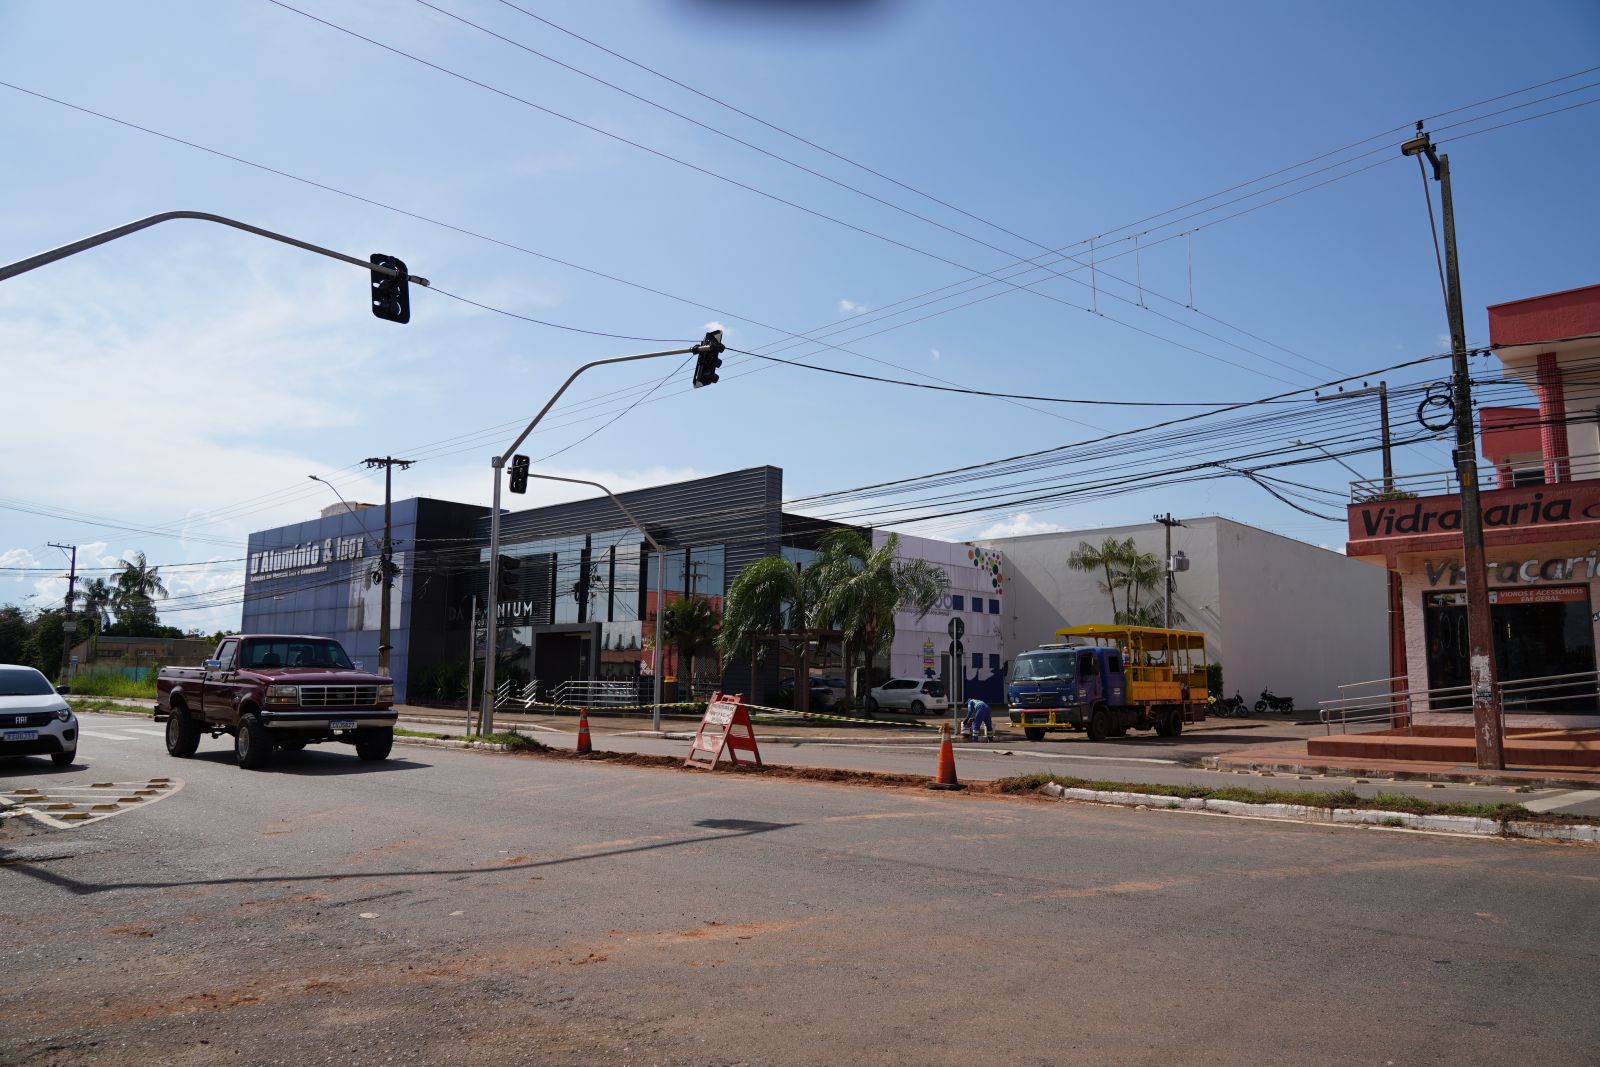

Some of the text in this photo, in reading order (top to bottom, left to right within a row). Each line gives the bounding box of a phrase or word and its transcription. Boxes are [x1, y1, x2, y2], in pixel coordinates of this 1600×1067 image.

[1361, 492, 1572, 536] Vidraaria
[250, 537, 365, 575] D'Alumínio & Inox
[1424, 550, 1600, 588] Viraçari
